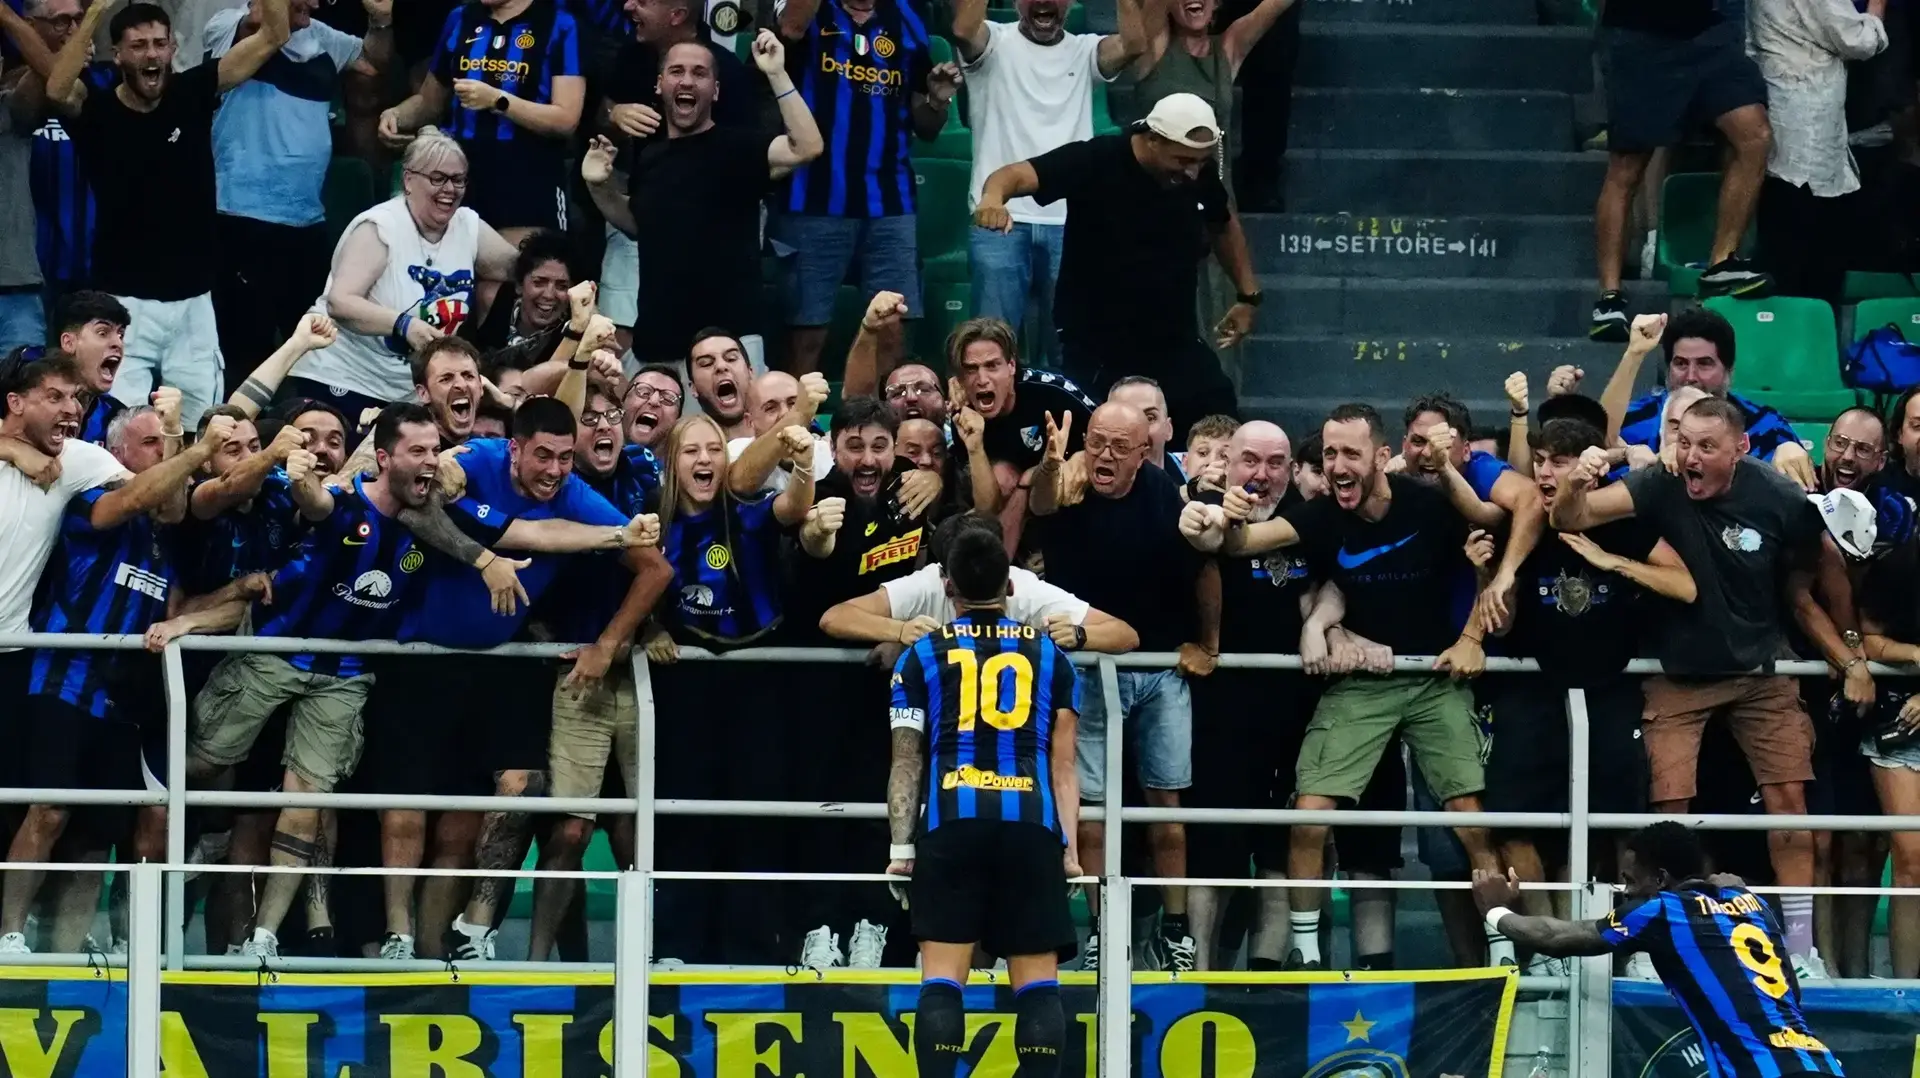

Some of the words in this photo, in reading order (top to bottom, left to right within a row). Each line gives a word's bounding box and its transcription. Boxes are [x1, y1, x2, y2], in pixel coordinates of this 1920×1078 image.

[460, 55, 529, 75] betsson
[821, 51, 902, 86] betsson
[494, 73, 526, 83] sport
[862, 83, 899, 96] sport
[1280, 234, 1311, 253] 139
[1335, 235, 1446, 255] SETTORE
[1469, 238, 1496, 257] 141
[114, 561, 168, 602] PIREL
[942, 624, 1036, 640] LAUTARO
[947, 648, 1034, 732] 10
[889, 707, 921, 723] EACE
[1729, 922, 1790, 1000] 9
[1019, 1046, 1056, 1055] INTER
